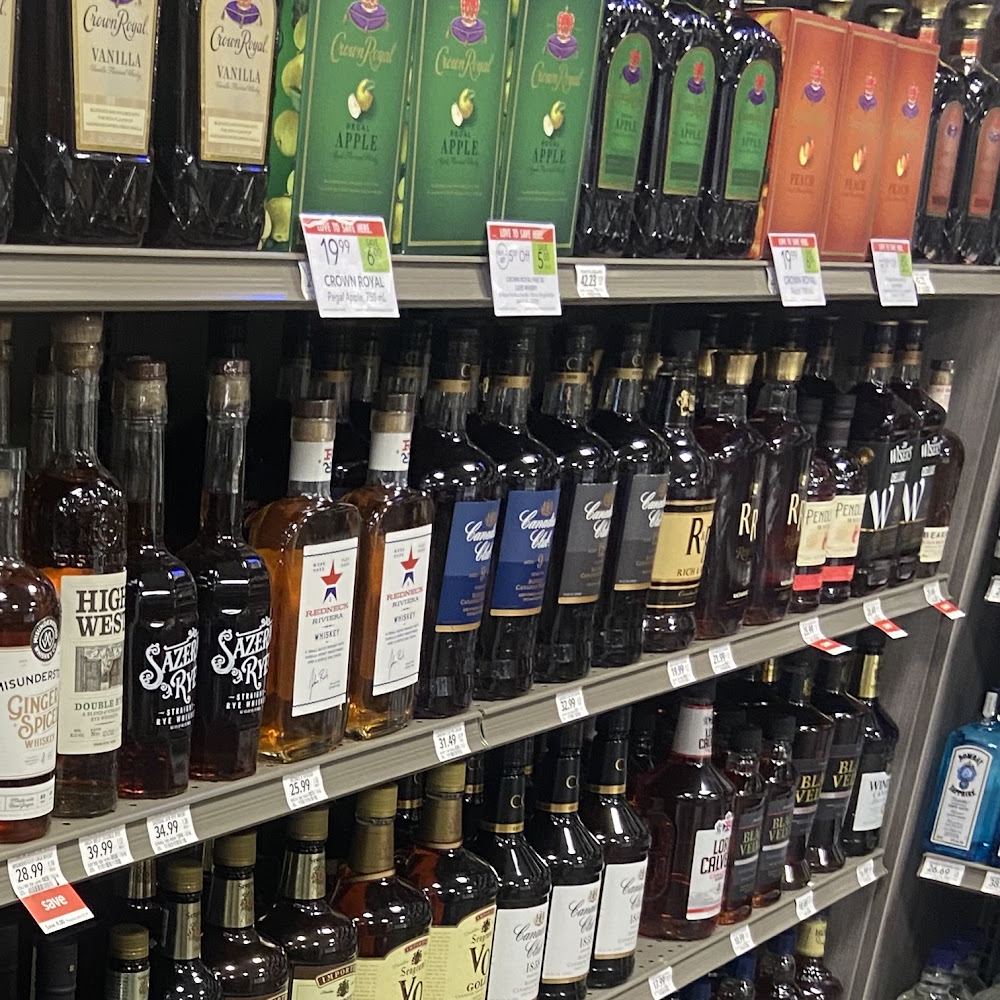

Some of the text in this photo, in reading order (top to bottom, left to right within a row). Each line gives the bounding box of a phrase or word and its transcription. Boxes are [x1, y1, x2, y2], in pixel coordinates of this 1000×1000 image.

[91, 47, 141, 69] VANILLA
[217, 65, 261, 84] VANILLA
[335, 132, 378, 152] APPLE
[441, 139, 479, 157] APPLE
[534, 148, 567, 165] APPLE
[324, 275, 384, 289] CROWN ROYAL
[580, 274, 597, 287] 42.23
[386, 587, 424, 600] REDNECK
[392, 596, 419, 608] RIVIERA
[305, 602, 349, 618] REDNECK
[394, 612, 416, 623] WHISKEY
[312, 613, 343, 625] RIVIERA
[314, 630, 340, 641] WHISKEY
[75, 700, 114, 712] DOUBLE
[560, 698, 577, 711] 32.99
[438, 735, 458, 749] 31.49
[288, 780, 310, 795] 25.99
[154, 820, 180, 840] 34.99
[86, 839, 115, 862] 39.99
[15, 862, 44, 884] 28.99
[40, 893, 68, 911] save
